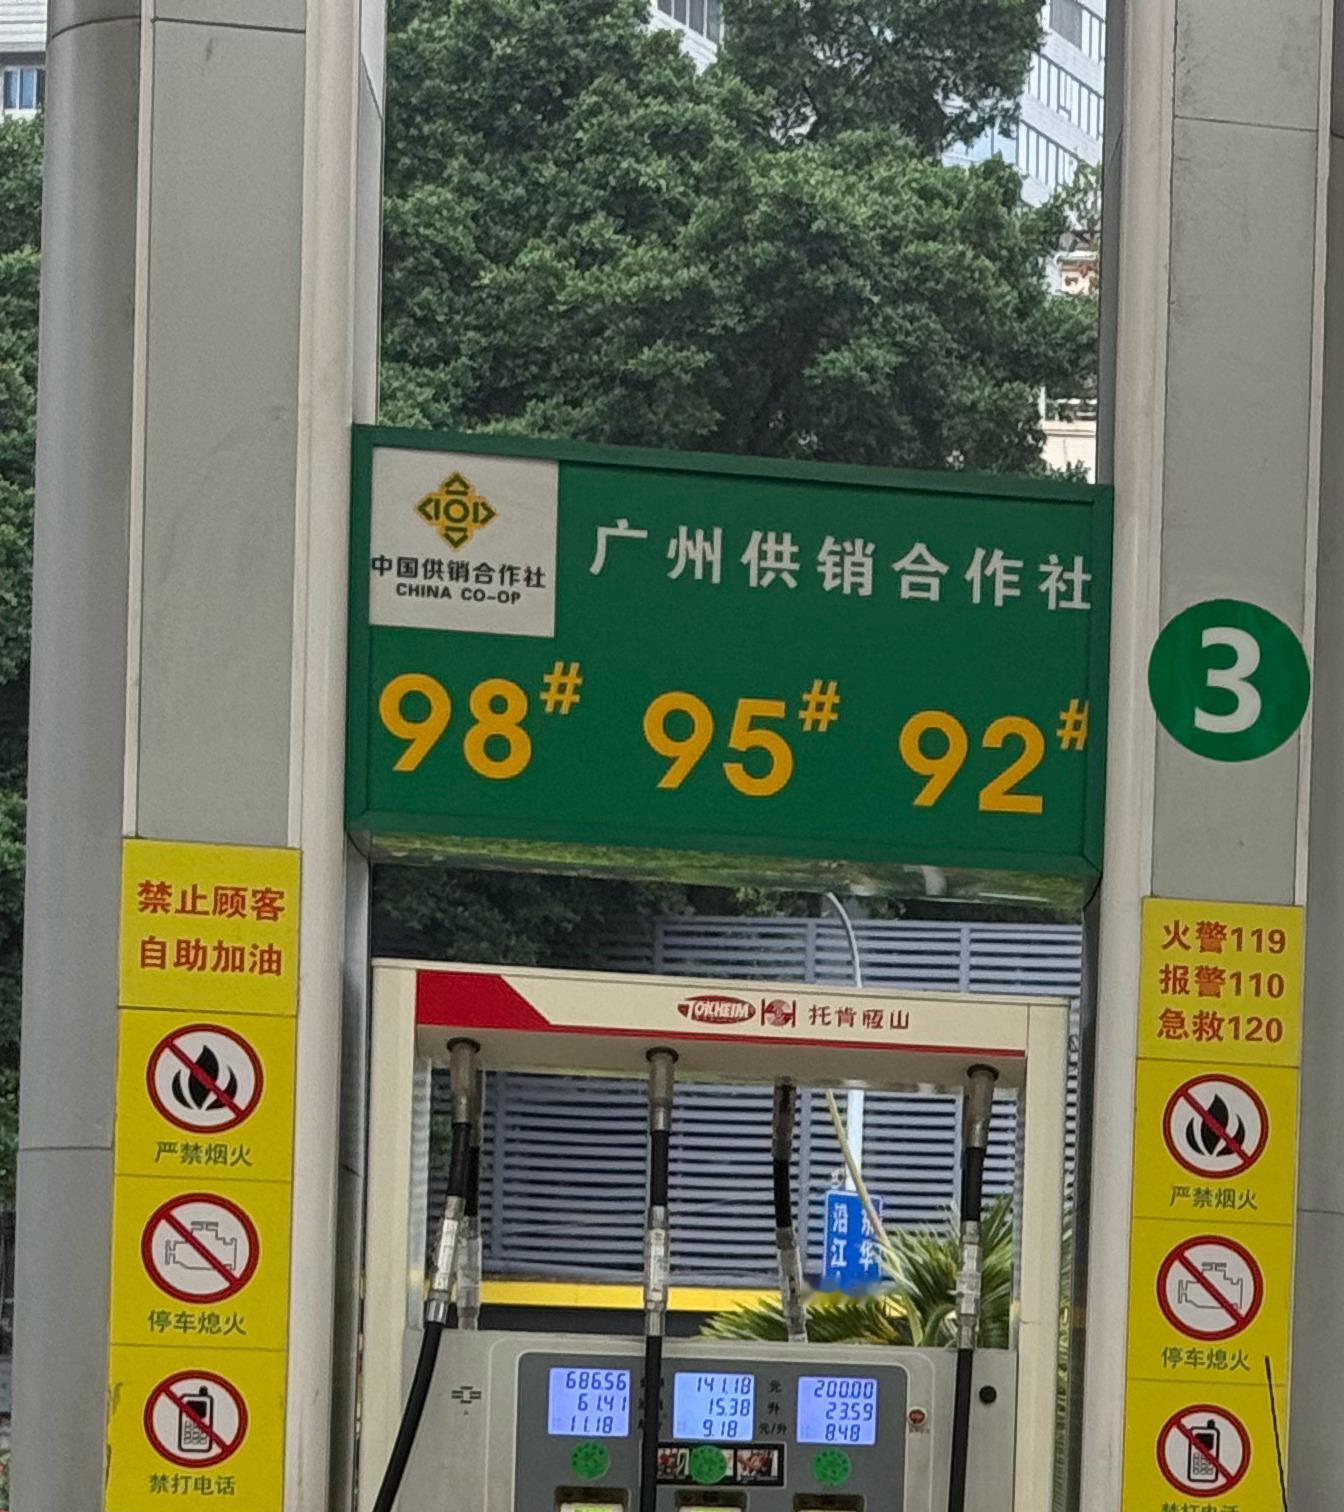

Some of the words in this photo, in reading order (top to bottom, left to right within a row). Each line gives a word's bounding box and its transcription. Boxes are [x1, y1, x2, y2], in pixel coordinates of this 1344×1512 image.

[371, 554, 547, 589] 中国供销合作社
[589, 517, 1092, 611] 广州供销合作社
[396, 582, 452, 600] CHINA
[460, 587, 521, 605] CO-OP
[1193, 625, 1263, 734] 3
[378, 660, 583, 780] 98#
[642, 678, 841, 797] 95#
[897, 698, 1089, 815] 92#
[137, 879, 287, 922] 禁止顾客
[1161, 919, 1286, 954] 火警119
[140, 934, 283, 977] 自助加油
[1159, 963, 1284, 999] 报警110
[1156, 1007, 1283, 1044] 急救120
[154, 1141, 254, 1168] 严禁烟火
[1169, 1184, 1258, 1211] 严禁烟火
[147, 1309, 247, 1337] 停车熄火
[1161, 1346, 1251, 1372] 停车熄火
[769, 1380, 783, 1393] 元
[767, 1402, 780, 1415] 升
[760, 1422, 788, 1436] 元/升
[149, 1472, 237, 1497] 禁打电话
